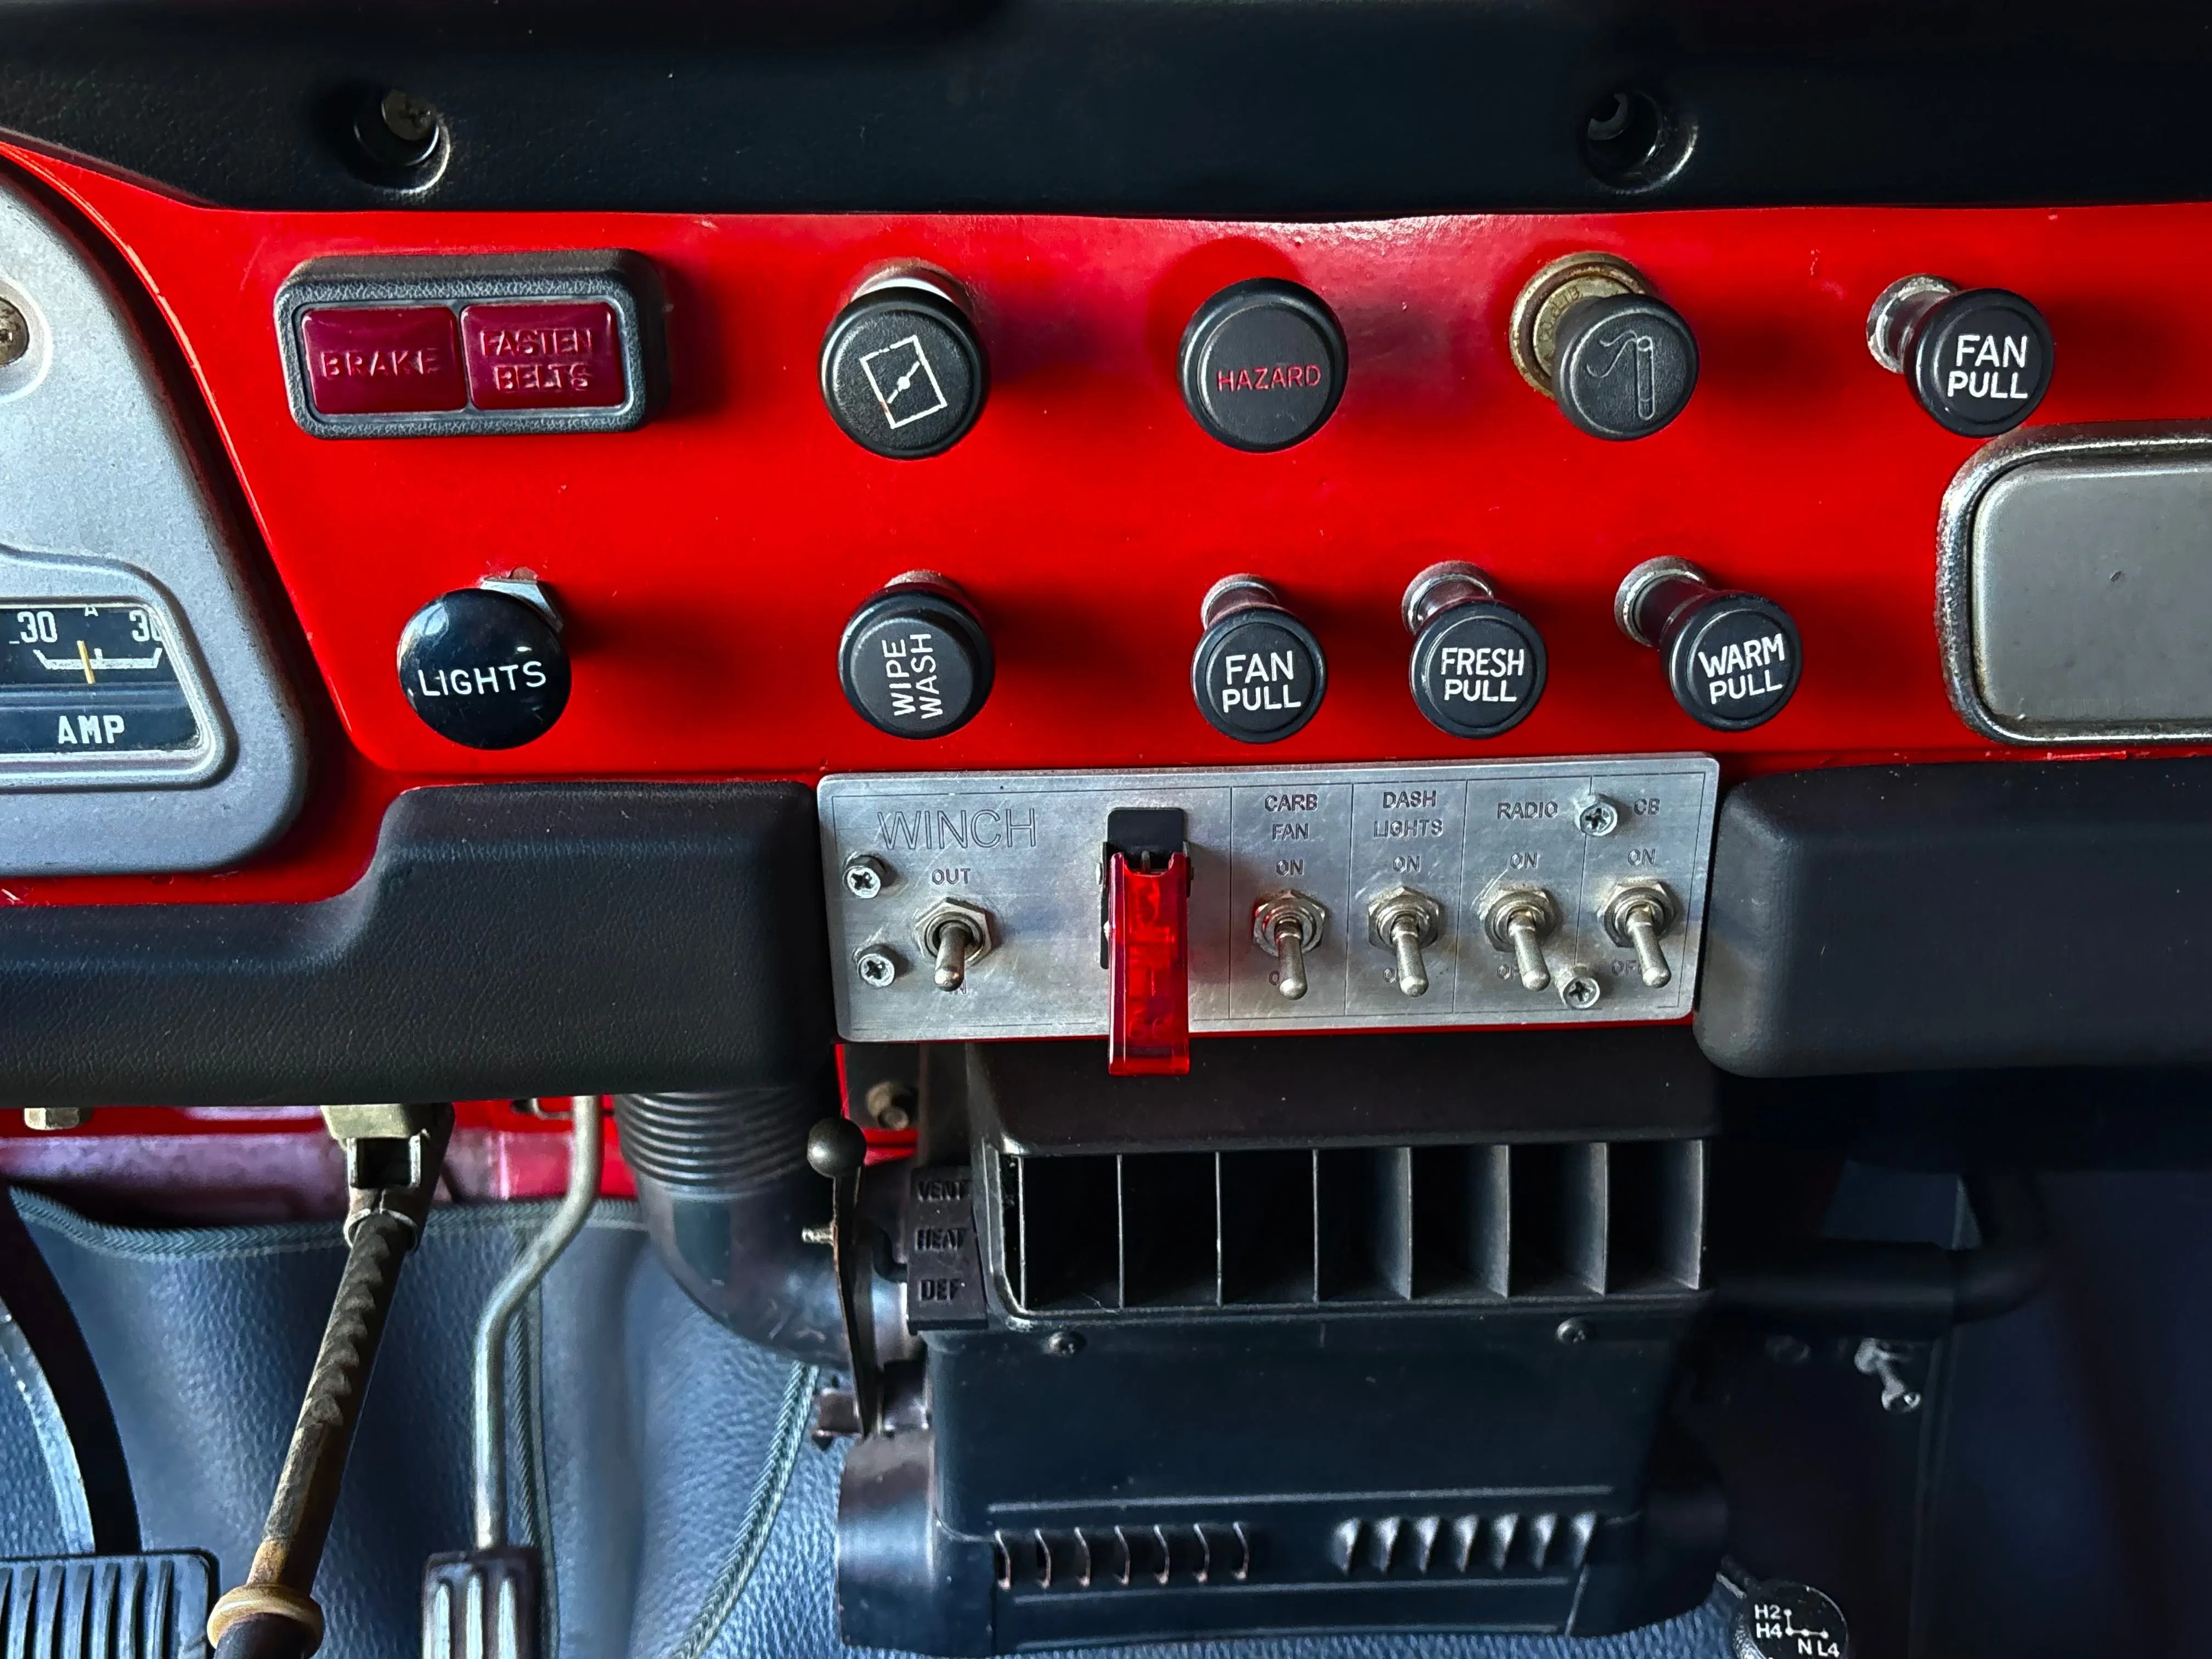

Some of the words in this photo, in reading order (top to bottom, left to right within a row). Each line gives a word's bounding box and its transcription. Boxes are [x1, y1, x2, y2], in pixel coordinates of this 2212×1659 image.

[479, 329, 594, 358] FASTEN
[1956, 334, 2028, 368] FAN
[320, 348, 441, 380] BRAKE
[493, 363, 594, 392] BELTS
[1216, 363, 1322, 392] HAZARD
[1947, 370, 2028, 399] PULL
[1226, 650, 1294, 685] FAN
[1441, 647, 1524, 678] FRESH
[1698, 633, 1785, 678] WARM
[417, 661, 546, 696] LIGHTS
[881, 639, 916, 716] WIPE
[910, 634, 943, 719] WASH
[1708, 669, 1782, 705] PULL
[1222, 684, 1302, 713] PULL
[1444, 679, 1517, 702] PULL
[58, 715, 126, 744] AMP
[1265, 794, 1318, 812] CARB
[1383, 790, 1437, 809] DASH
[1497, 802, 1558, 820] RADIO
[1633, 798, 1661, 815] CB
[877, 808, 1036, 850] WINCH
[1272, 823, 1309, 840] FAN
[1373, 819, 1443, 838] LIGHTS
[1276, 859, 1304, 876] ON
[1392, 855, 1421, 873] ON
[1510, 852, 1539, 870] ON
[1627, 849, 1656, 866] ON
[932, 868, 971, 884] OUT
[1497, 964, 1519, 980] OF
[914, 1228, 967, 1252] HEAT
[917, 1278, 961, 1302] DEF
[1754, 1604, 1781, 1619] H2
[1756, 1622, 1782, 1639] H4
[1797, 1638, 1812, 1655] N
[1817, 1639, 1840, 1658] L4
